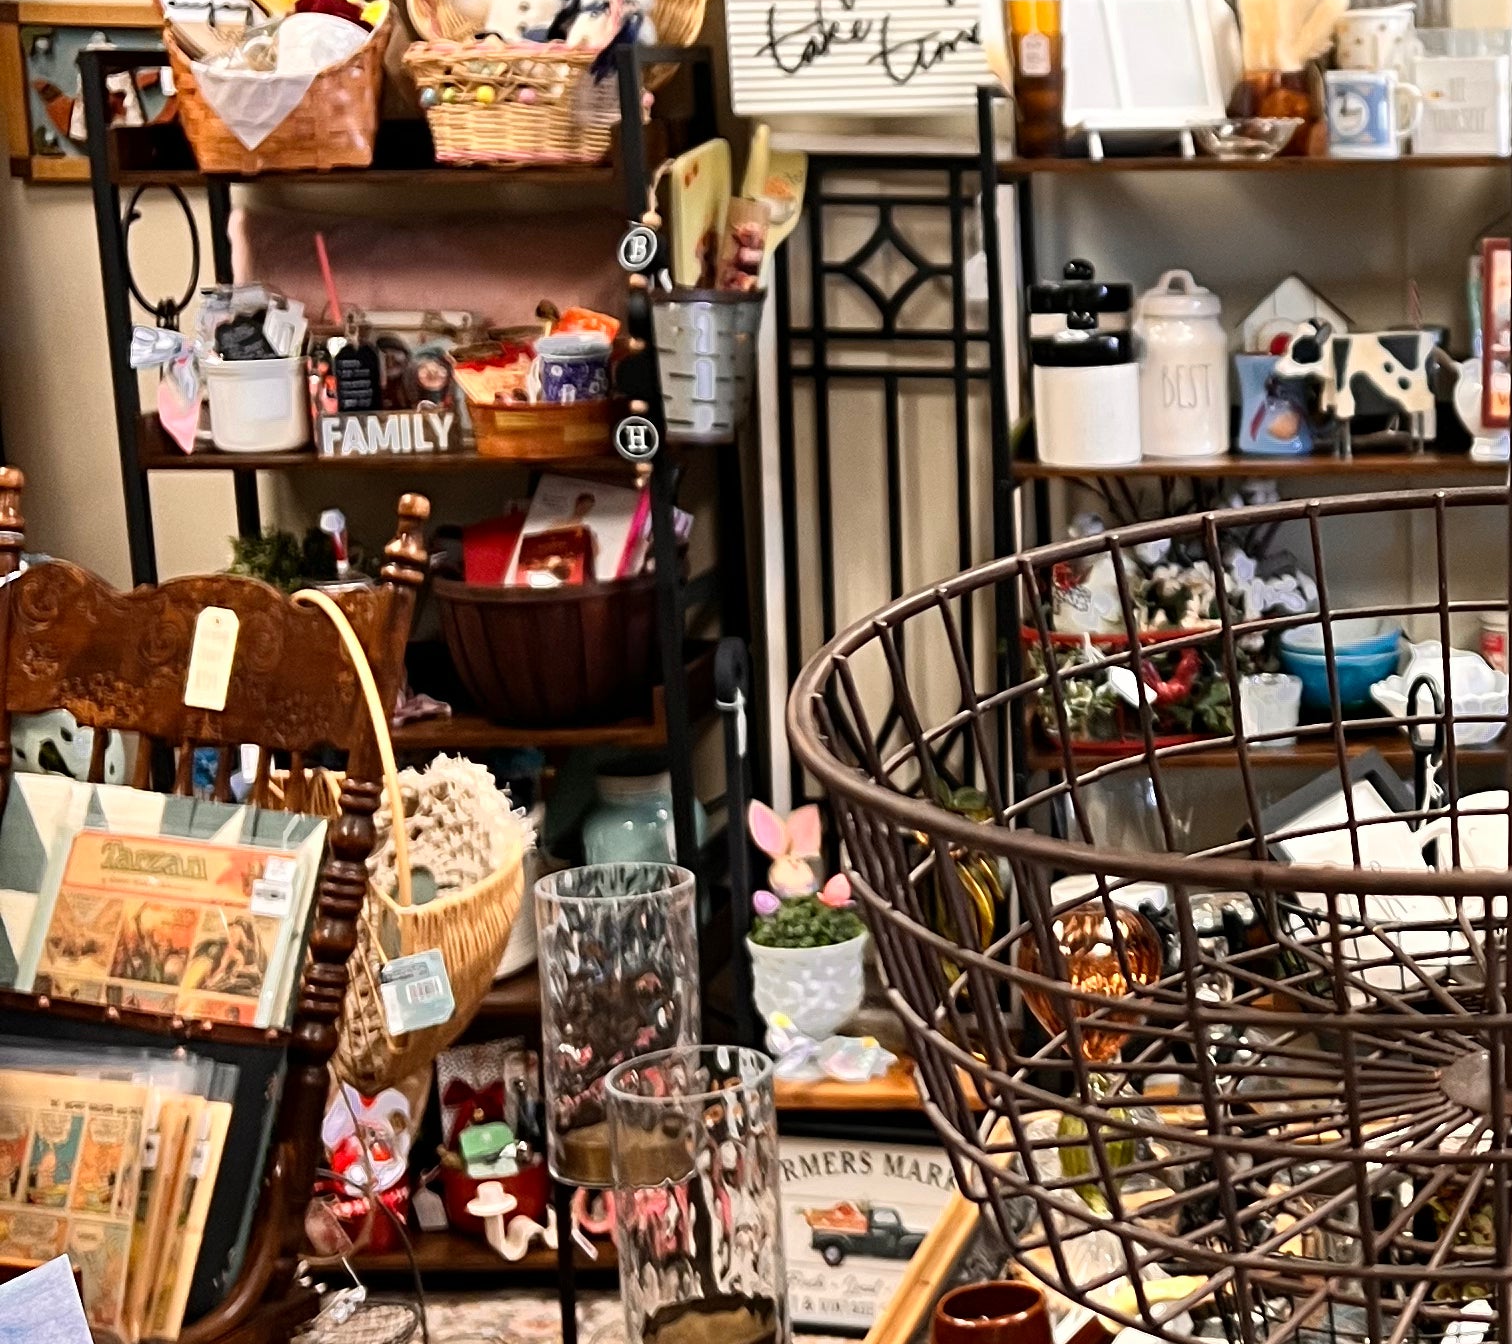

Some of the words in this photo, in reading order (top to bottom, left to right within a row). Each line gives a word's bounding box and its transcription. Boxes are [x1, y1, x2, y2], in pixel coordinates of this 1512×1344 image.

[755, 0, 873, 74] take
[1161, 363, 1212, 408] BEST
[321, 412, 453, 455] FAMILY
[626, 425, 648, 451] H
[100, 839, 208, 881] Tarzan
[778, 1149, 874, 1182] RMERS
